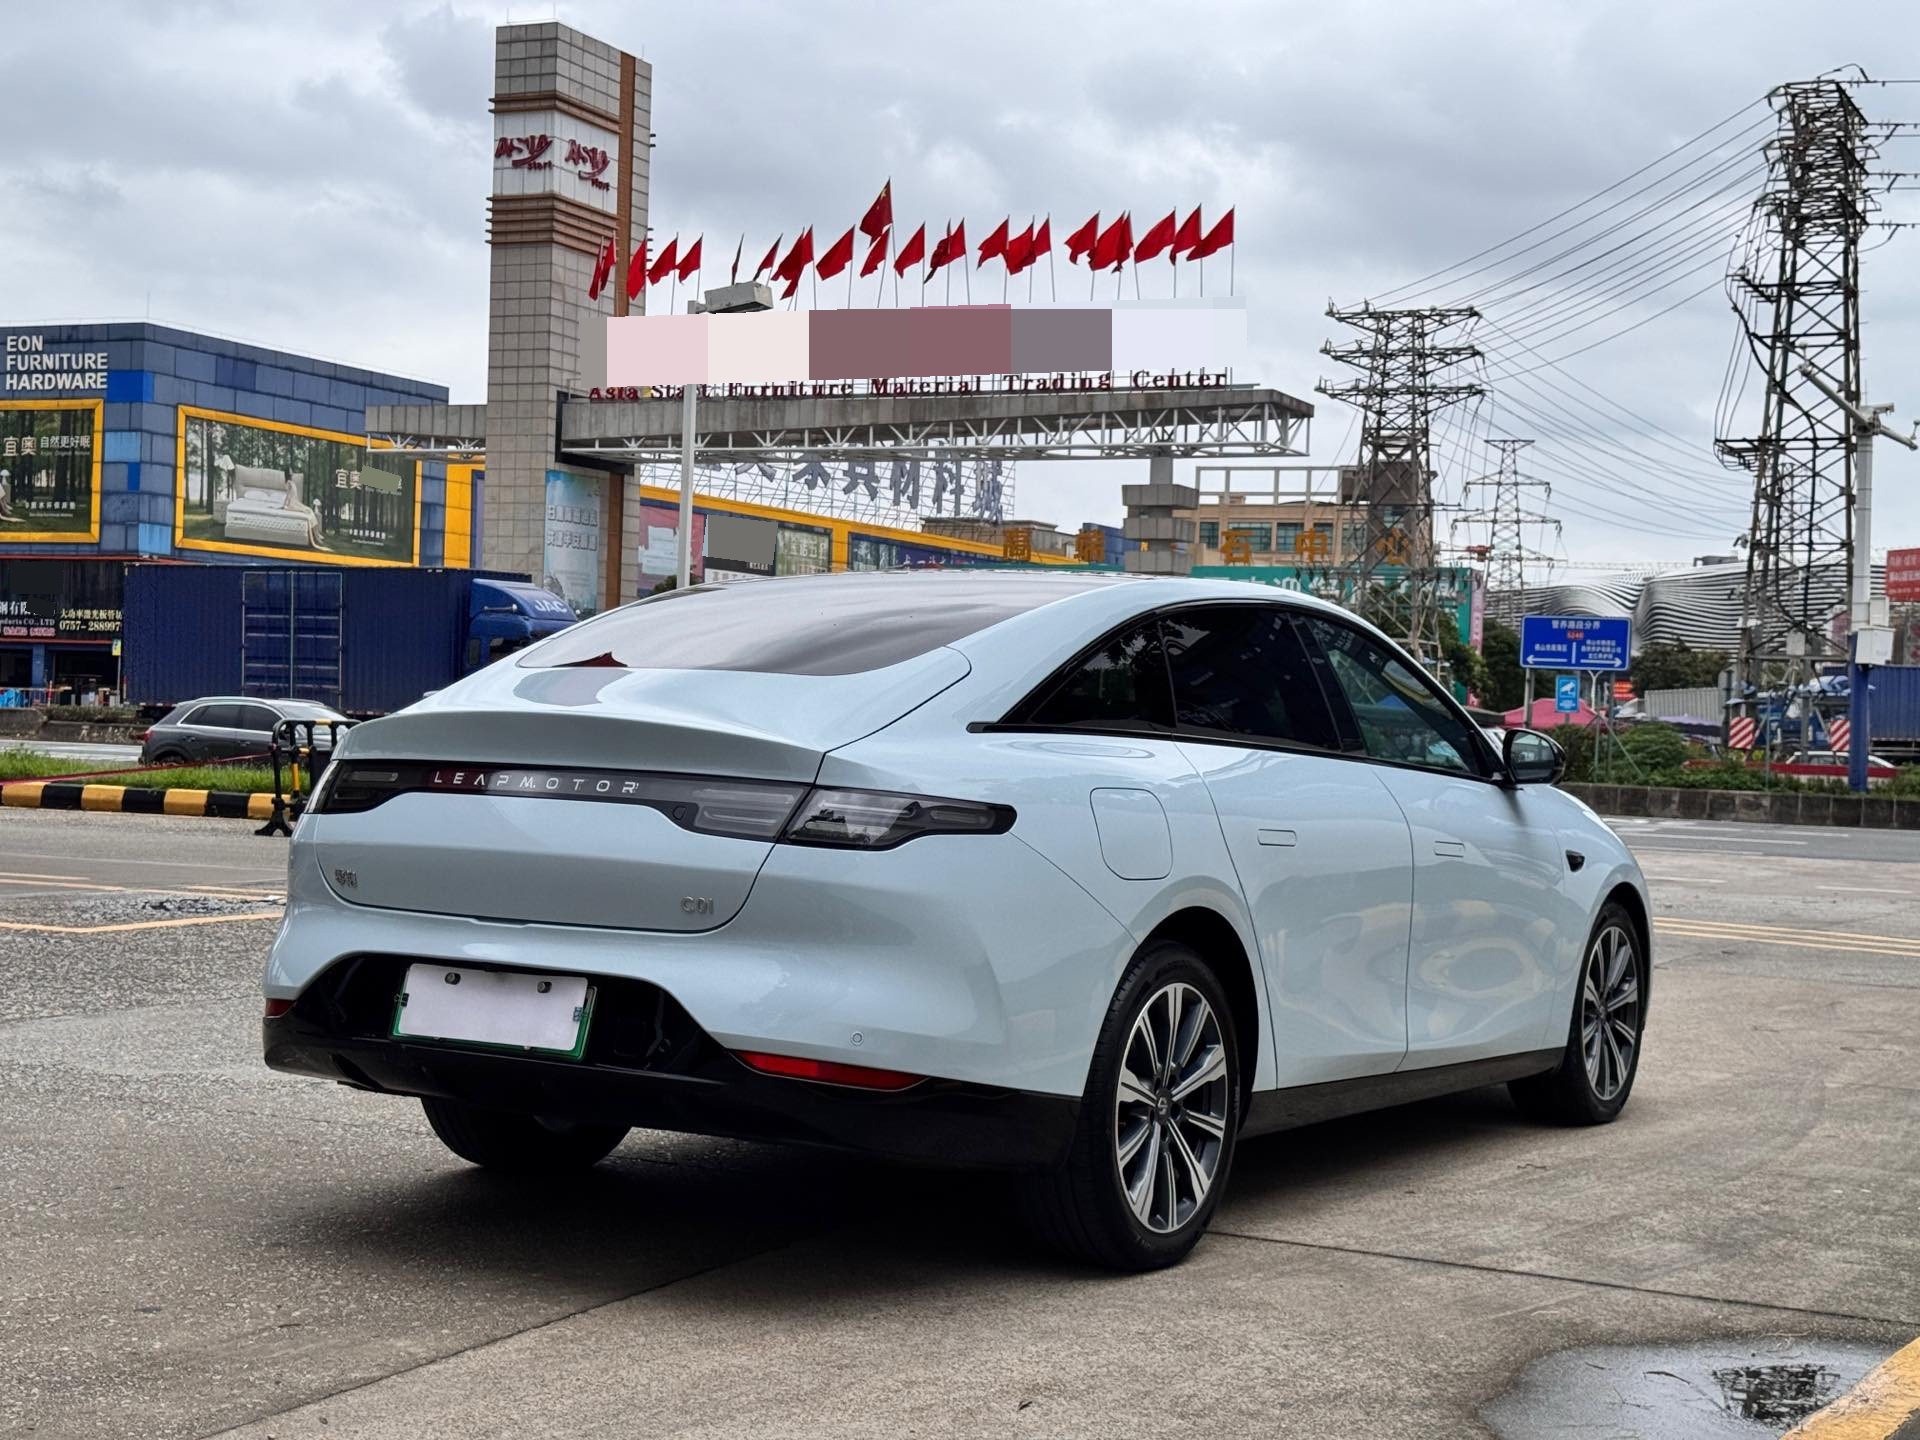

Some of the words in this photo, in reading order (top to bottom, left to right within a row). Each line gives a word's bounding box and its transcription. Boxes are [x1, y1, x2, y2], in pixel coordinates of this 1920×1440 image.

[6, 335, 44, 352] EON
[6, 352, 108, 371] FURNITURE
[6, 372, 108, 390] HARDWARE
[588, 386, 640, 401] Asia
[727, 382, 853, 398] Furniture
[869, 376, 982, 397] Material
[1003, 372, 1112, 392] Trading
[1132, 370, 1227, 390] Center
[3, 435, 38, 457] 宜奥
[40, 435, 92, 449] 自然更好眠
[534, 599, 568, 614] JAC
[433, 770, 640, 795] LEAPMOTOR
